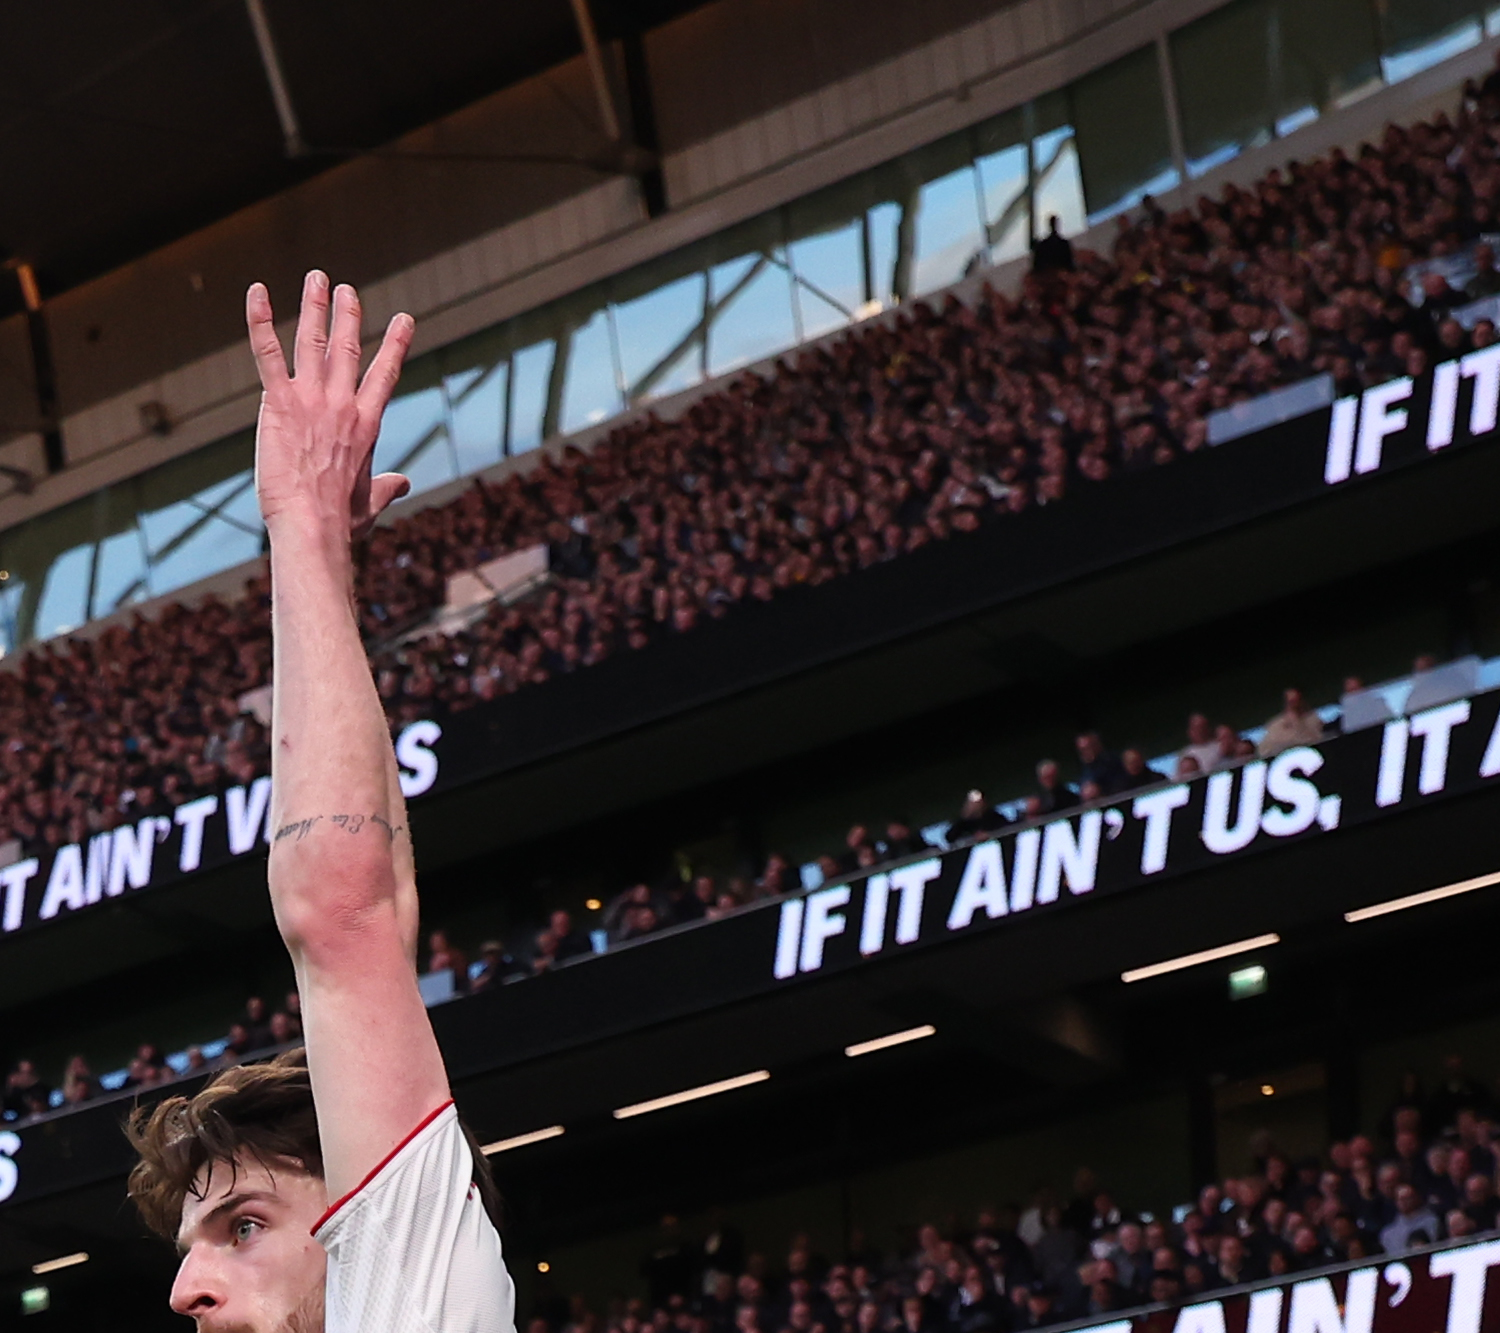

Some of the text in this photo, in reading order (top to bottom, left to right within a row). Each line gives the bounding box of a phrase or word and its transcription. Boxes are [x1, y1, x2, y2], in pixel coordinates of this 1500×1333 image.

[1326, 379, 1413, 484] IF
[41, 797, 217, 919] AIN'T
[775, 887, 850, 979] IF
[860, 859, 942, 955] IT
[948, 785, 1190, 930] AIN'T
[1377, 702, 1470, 806] IT
